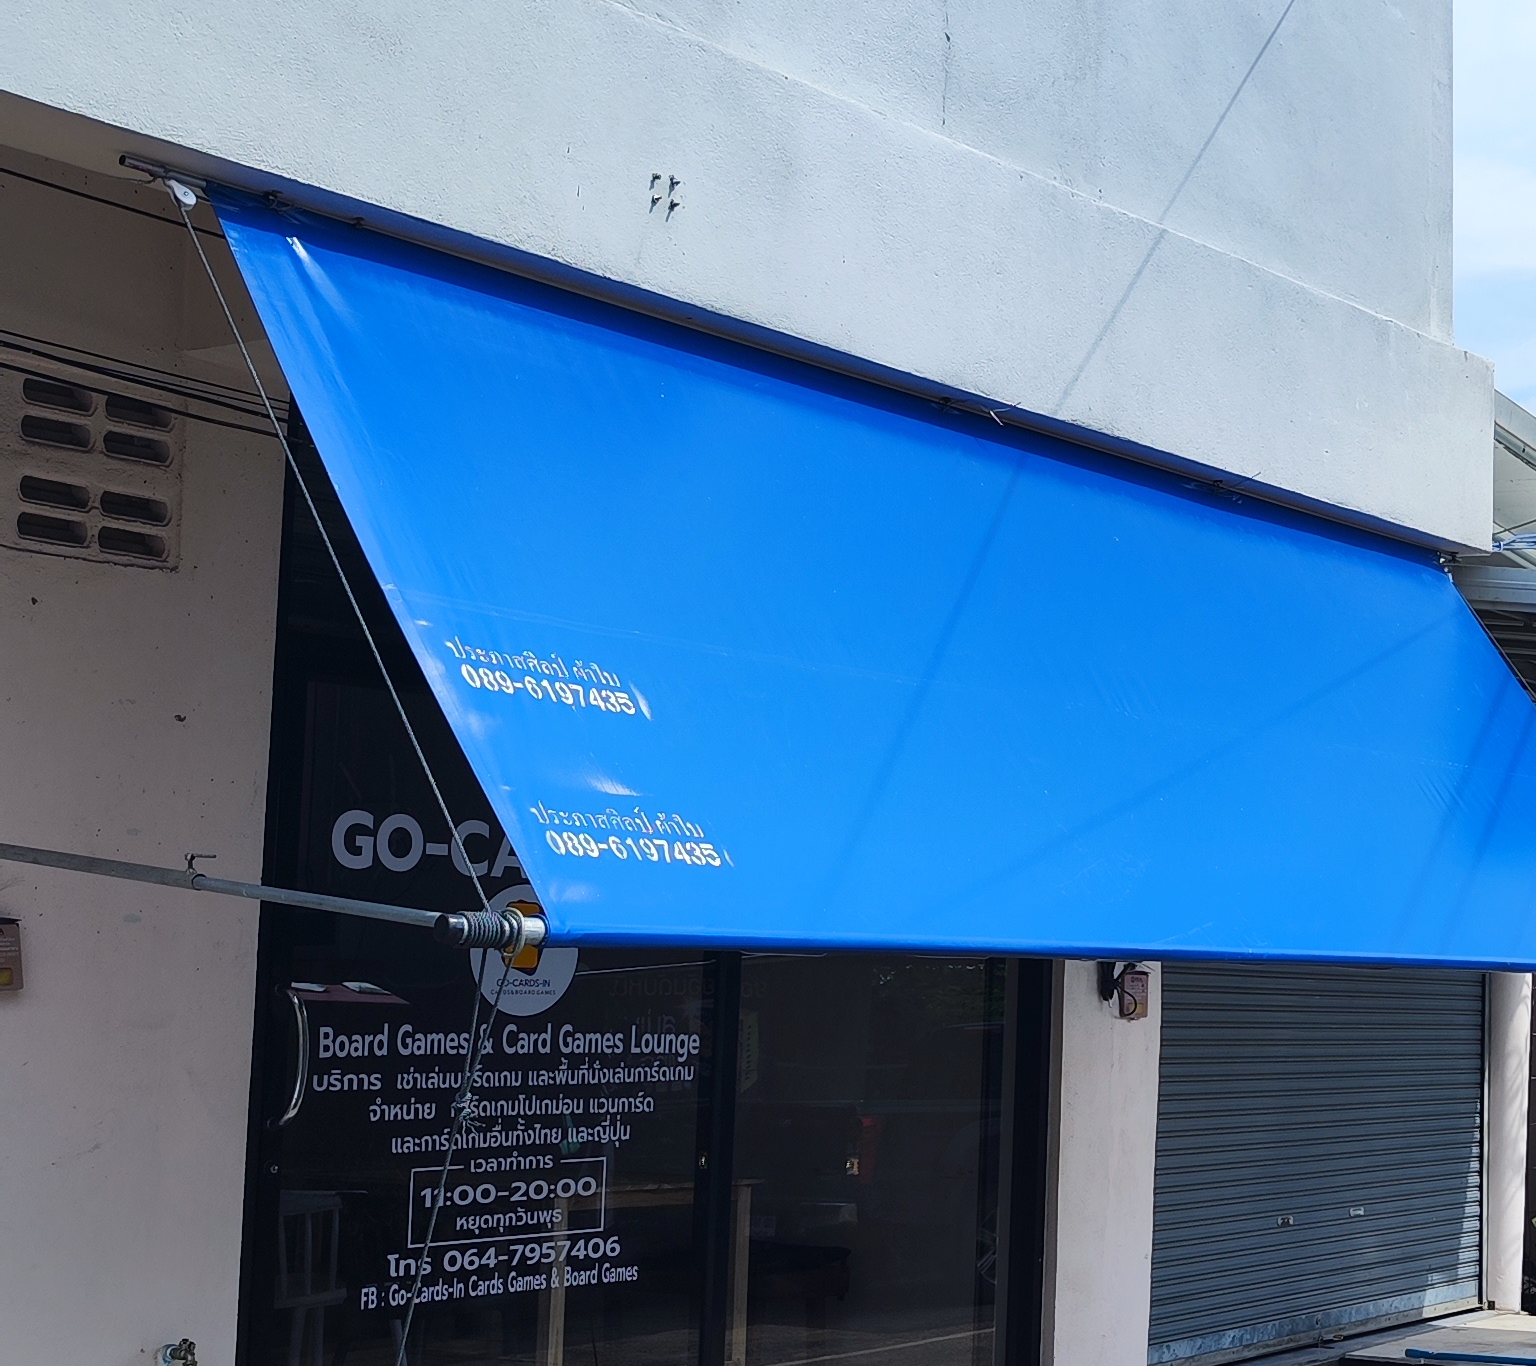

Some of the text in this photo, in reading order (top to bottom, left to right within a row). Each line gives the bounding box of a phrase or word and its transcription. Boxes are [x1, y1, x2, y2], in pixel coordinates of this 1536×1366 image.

[461, 663, 636, 715] 089-6197435
[545, 829, 722, 867] 089-6197435
[318, 1023, 389, 1059] Board
[397, 1024, 470, 1056] Games
[478, 1024, 494, 1055] &
[502, 1023, 552, 1055] Card
[559, 1024, 624, 1055] Games
[630, 1024, 700, 1063] Lounge
[312, 1057, 695, 1092] บริการ เช่าเล่นบร์ดเกม และพื้นที่นั่งเล่นการ์ดเกม
[369, 1091, 654, 1122] จำหน่าย กร์ดเกมโปเกม่อน แวนการ์ด
[567, 1115, 631, 1148] และญี่ปุ่น
[470, 1152, 554, 1173] เวลาทำการ
[420, 1176, 597, 1208] 11:00-20:00
[456, 1207, 563, 1235] หยุดทุกวันพุธ
[387, 1237, 621, 1278] โทร 064-7957406
[360, 1287, 378, 1310] FB
[388, 1277, 465, 1307] Go-Cards-In
[469, 1272, 504, 1297] Cards
[507, 1272, 547, 1293] Games
[550, 1269, 560, 1289] &
[564, 1263, 598, 1287] Board
[602, 1261, 638, 1283] Games
